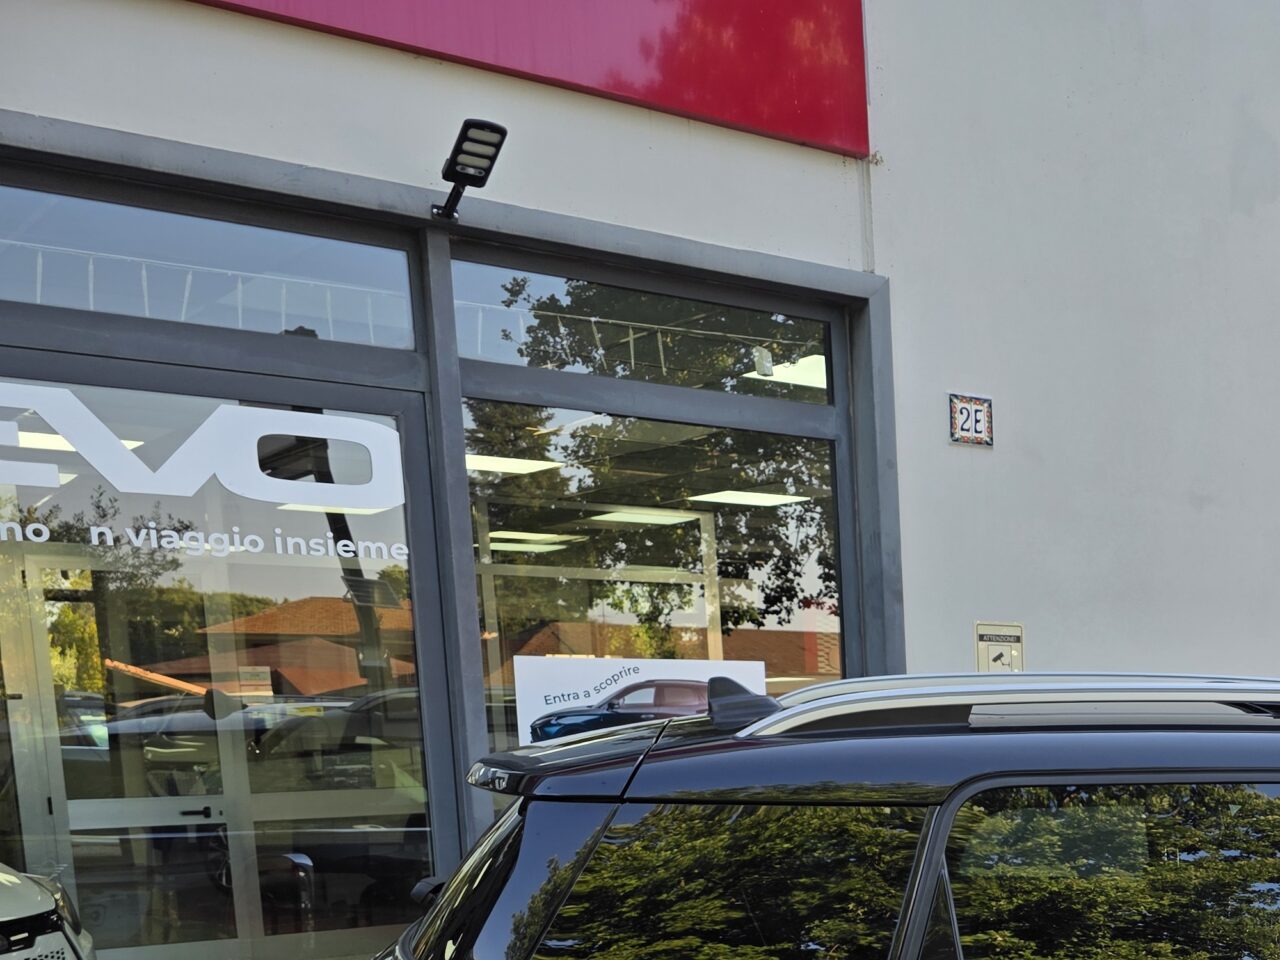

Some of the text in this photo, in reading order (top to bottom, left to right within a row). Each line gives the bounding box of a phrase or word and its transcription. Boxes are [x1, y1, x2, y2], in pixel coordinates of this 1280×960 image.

[959, 406, 983, 434] 2E
[124, 521, 265, 557] viaggio
[274, 527, 409, 561] insieme
[544, 666, 640, 706] Entra a scoprire
